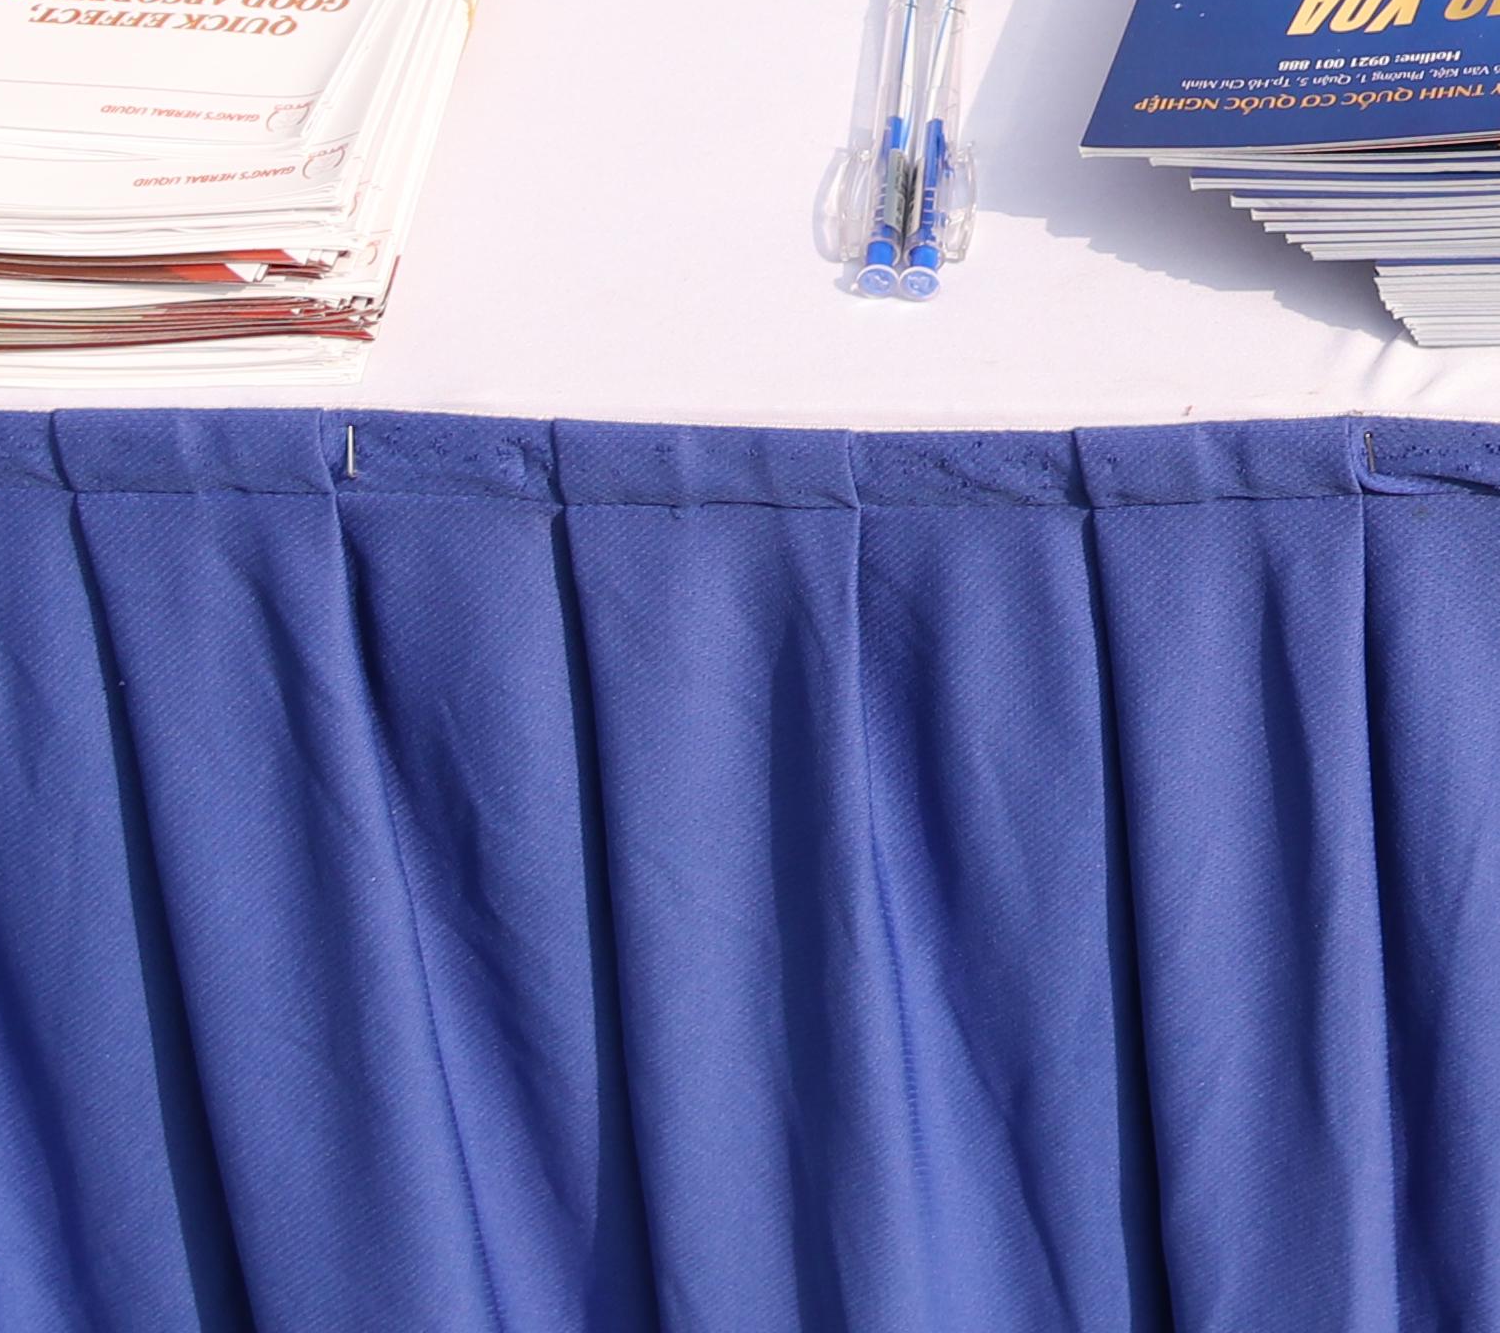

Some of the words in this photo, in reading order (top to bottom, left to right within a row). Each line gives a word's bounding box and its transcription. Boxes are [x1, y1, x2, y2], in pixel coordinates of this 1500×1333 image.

[28, 4, 172, 28] EFFECT,
[172, 12, 298, 36] QUICK
[1279, 58, 1309, 71] 888
[1314, 57, 1345, 70] 001
[1350, 53, 1390, 69] 0921
[1394, 49, 1461, 65] Hotline:
[1182, 79, 1216, 91] Minh
[1419, 83, 1484, 101] TNHH
[1134, 95, 1219, 111] NGHIỆP
[1224, 93, 1296, 115] QUỐC
[1299, 92, 1336, 109] CƠ
[1343, 87, 1413, 107] QUỐC
[101, 105, 147, 116] LIQUID
[152, 108, 200, 119] HERBAL
[204, 112, 260, 122] GIANG'S
